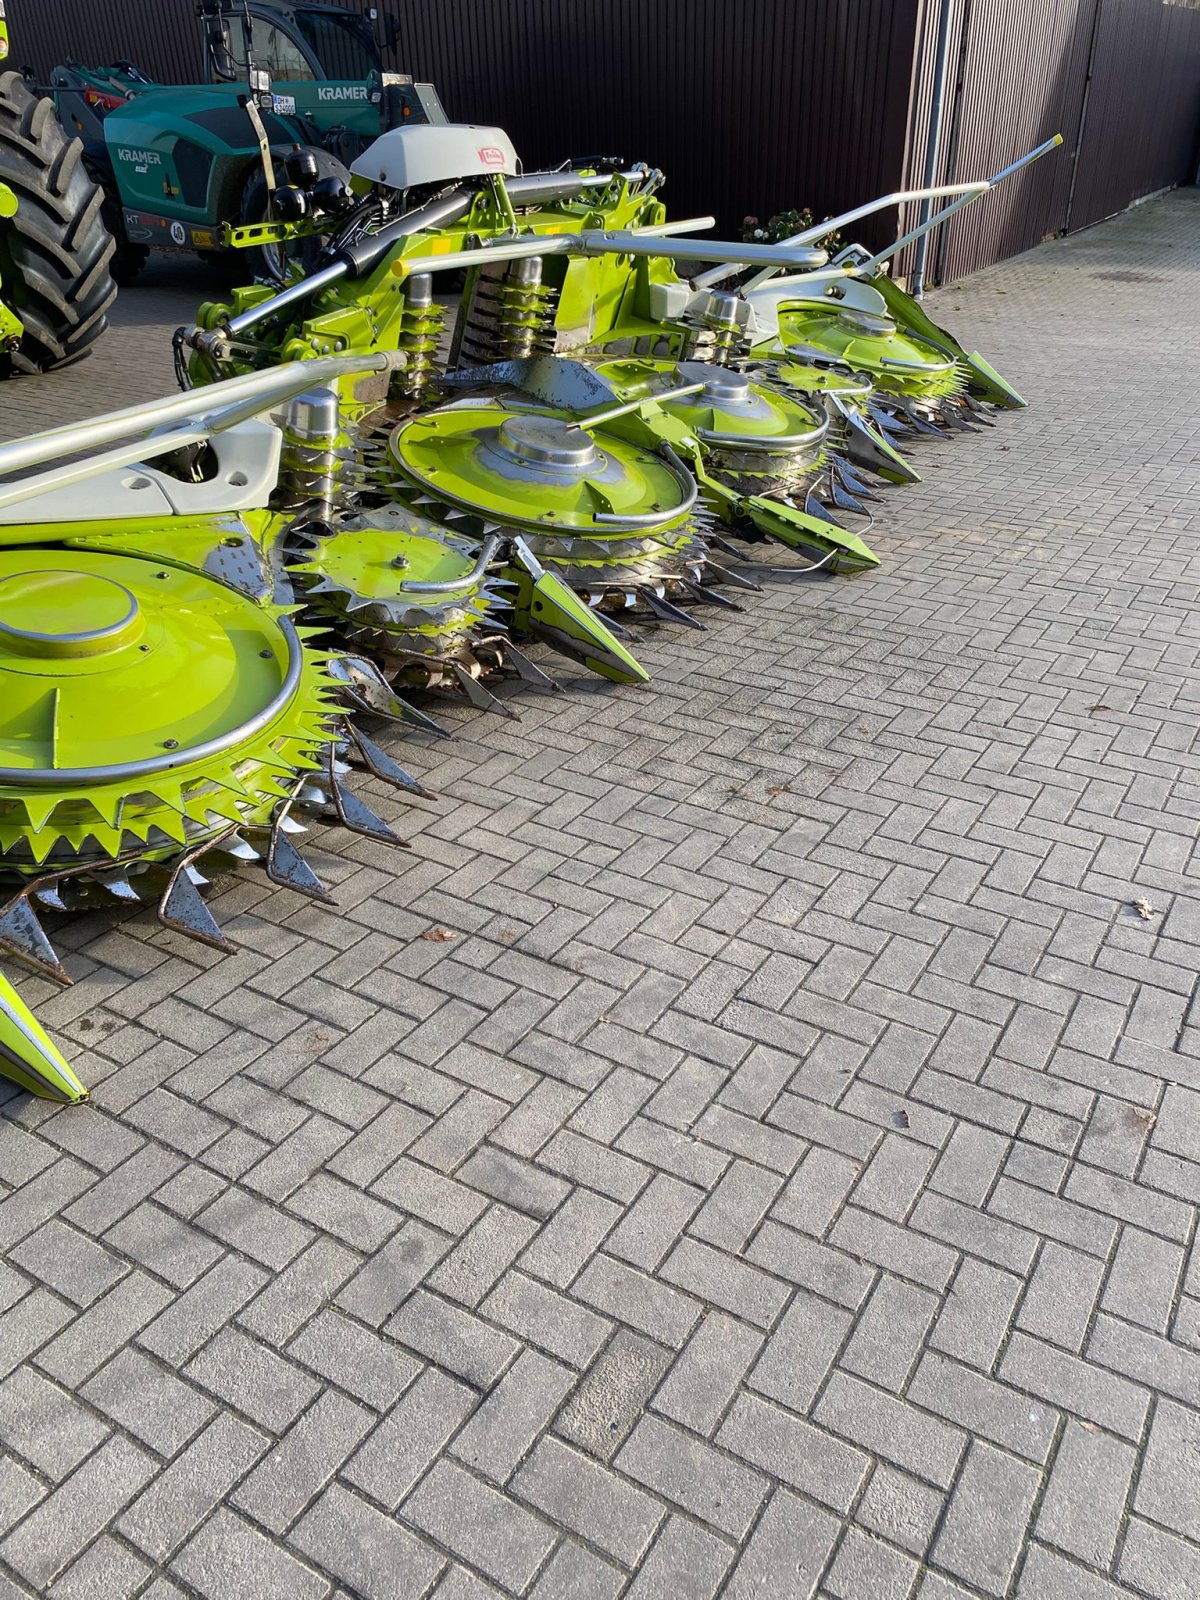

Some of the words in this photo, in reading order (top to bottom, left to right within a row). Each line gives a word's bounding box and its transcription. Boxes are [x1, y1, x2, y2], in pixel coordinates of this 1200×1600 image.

[318, 86, 368, 100] KRAMER
[117, 148, 162, 165] KRAMER
[173, 225, 183, 241] 40
